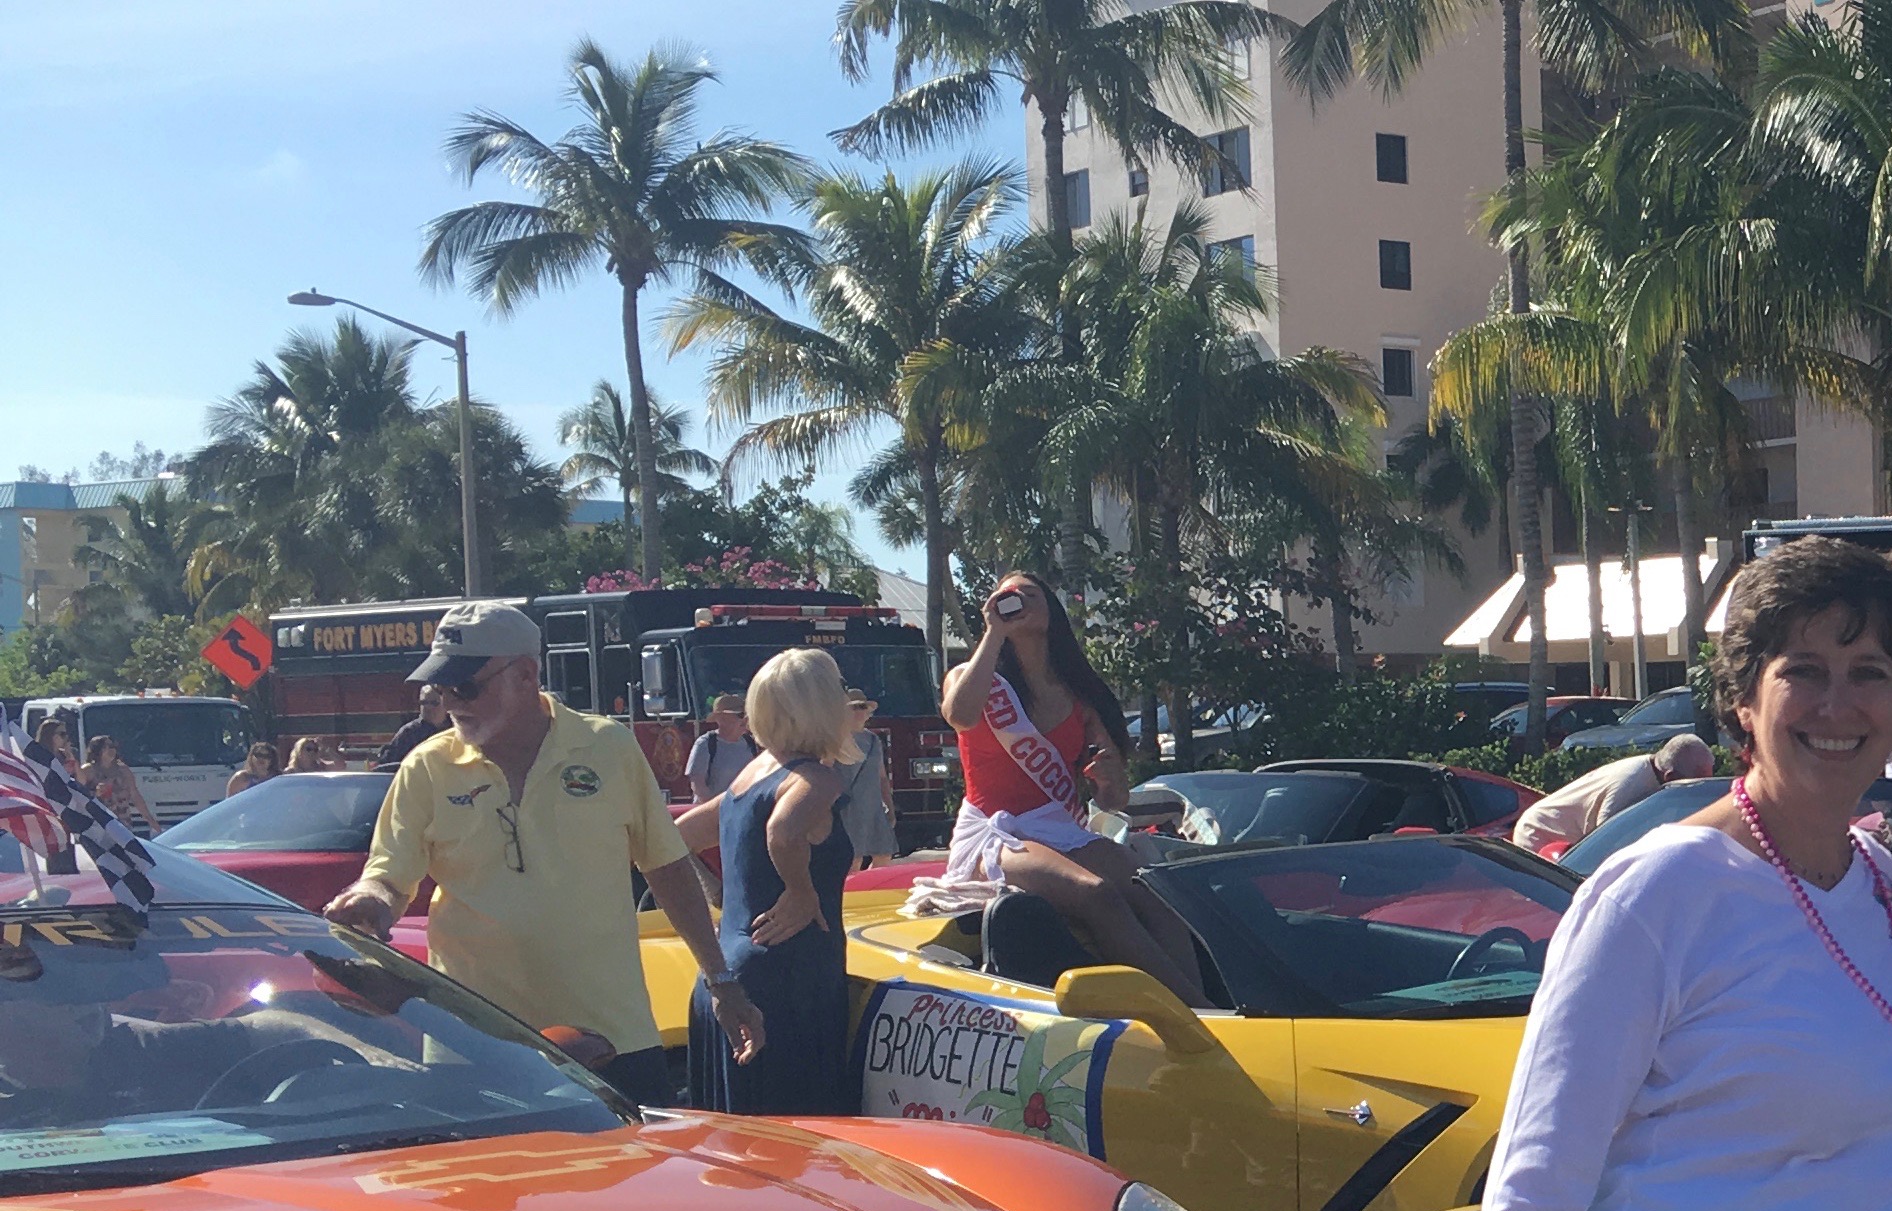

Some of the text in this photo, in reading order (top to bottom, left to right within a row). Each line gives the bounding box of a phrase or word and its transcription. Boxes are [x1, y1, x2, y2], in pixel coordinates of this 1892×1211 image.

[313, 626, 355, 651] FORT
[360, 622, 418, 649] MYERS
[869, 1013, 1026, 1096] BRIDGETTE
